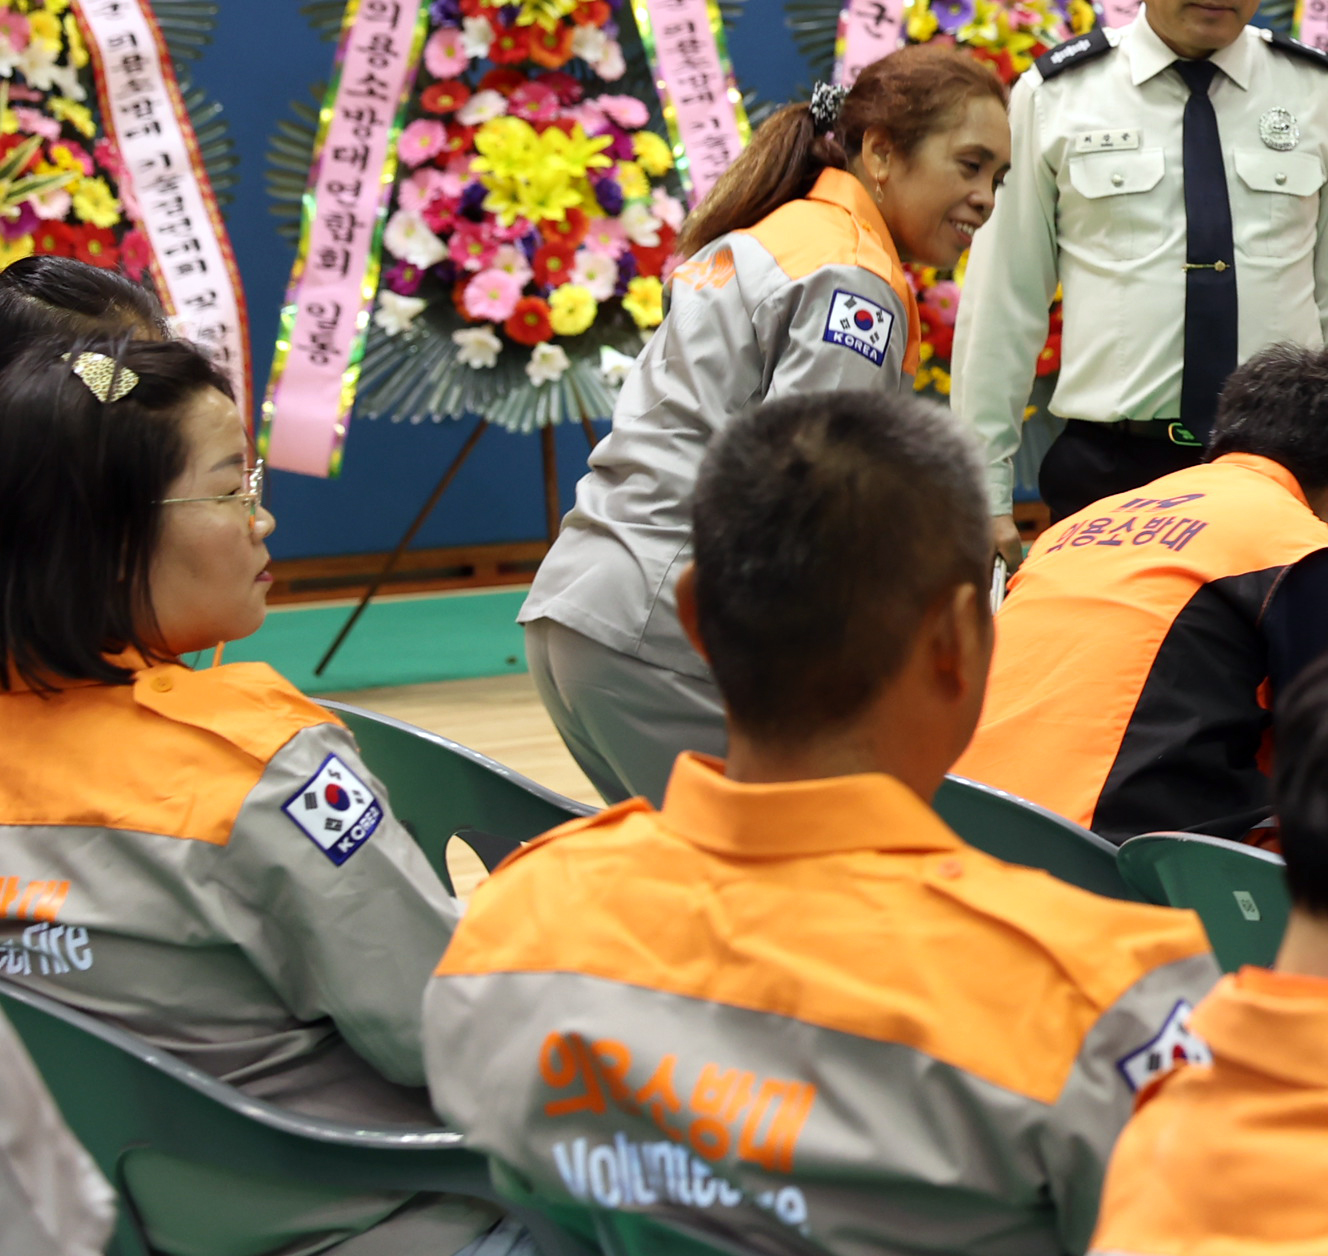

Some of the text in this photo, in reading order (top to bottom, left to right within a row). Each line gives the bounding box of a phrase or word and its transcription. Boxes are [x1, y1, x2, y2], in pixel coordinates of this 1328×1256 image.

[833, 331, 879, 362] KOREA
[1108, 493, 1207, 513] 119
[1045, 516, 1208, 553] 의용소방대
[338, 806, 380, 853] KOREA
